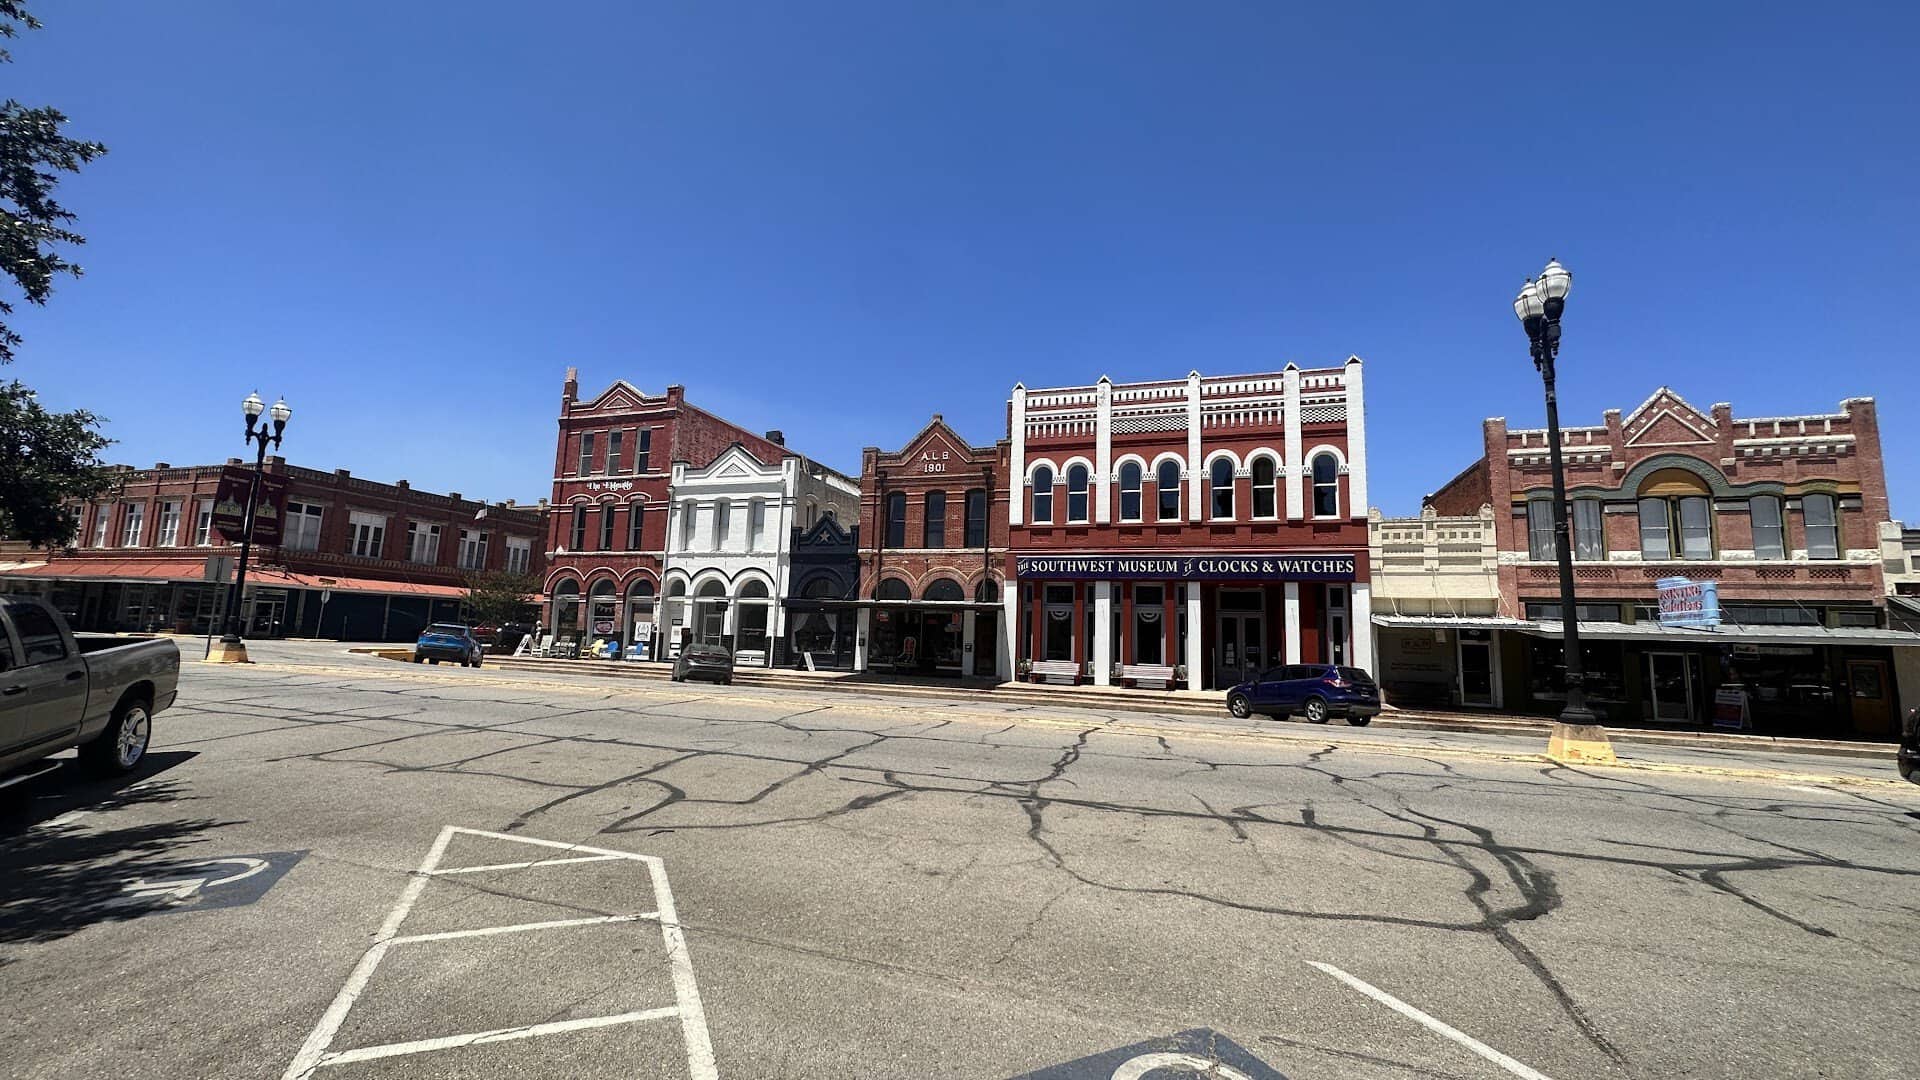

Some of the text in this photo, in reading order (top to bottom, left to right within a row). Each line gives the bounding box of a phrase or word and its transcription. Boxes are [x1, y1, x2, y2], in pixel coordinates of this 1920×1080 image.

[924, 463, 945, 473] 1901
[1031, 560, 1115, 573] SOUTHWEST
[1118, 560, 1178, 573] MUSEUM
[1198, 560, 1258, 573] CLOCKS
[1261, 560, 1274, 573] &
[1277, 560, 1354, 573] WATCHES
